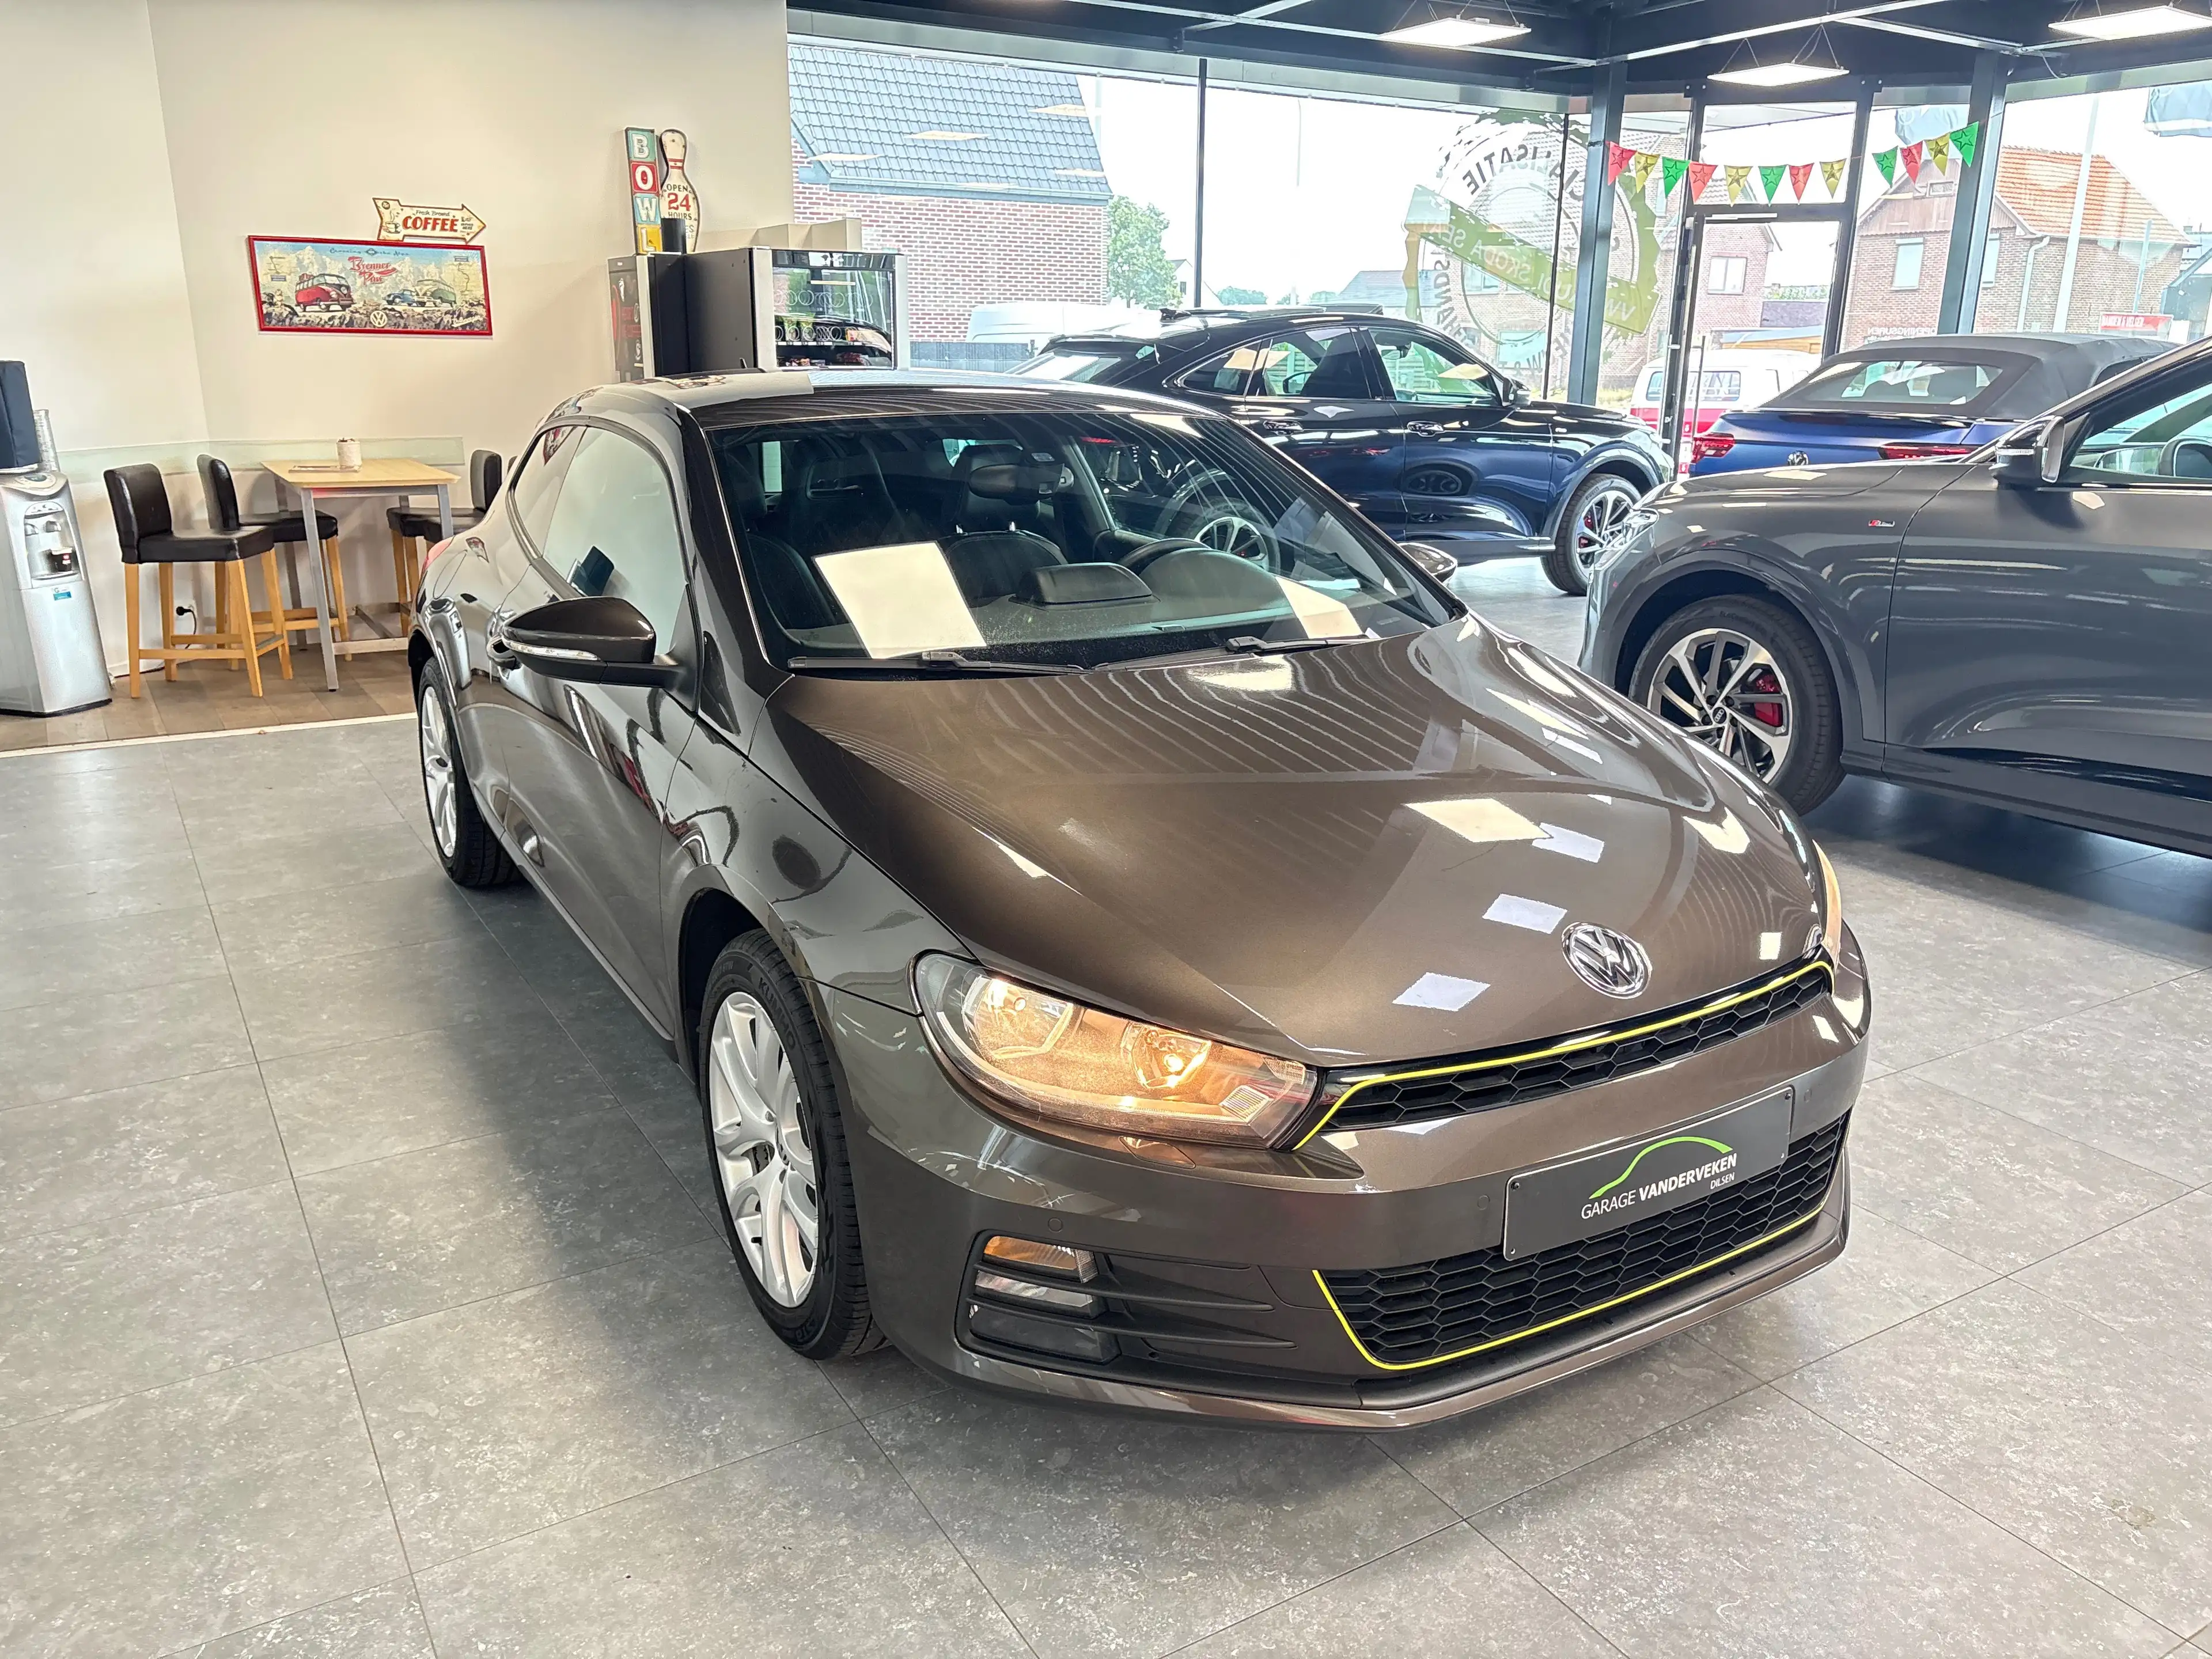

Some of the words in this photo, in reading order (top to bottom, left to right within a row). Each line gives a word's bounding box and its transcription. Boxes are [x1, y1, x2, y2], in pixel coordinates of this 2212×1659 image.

[632, 133, 657, 252] BOWL
[666, 183, 688, 192] OPEN
[667, 192, 691, 211] 24
[402, 215, 459, 232] COFFEE
[668, 211, 693, 221] HOURS
[347, 256, 392, 272] Brenner
[757, 976, 797, 1050] KUMHO
[1581, 1189, 1637, 1220] GARAGE
[1638, 1152, 1738, 1202] VANDERVEKEN
[1710, 1172, 1735, 1190] DILSEN
